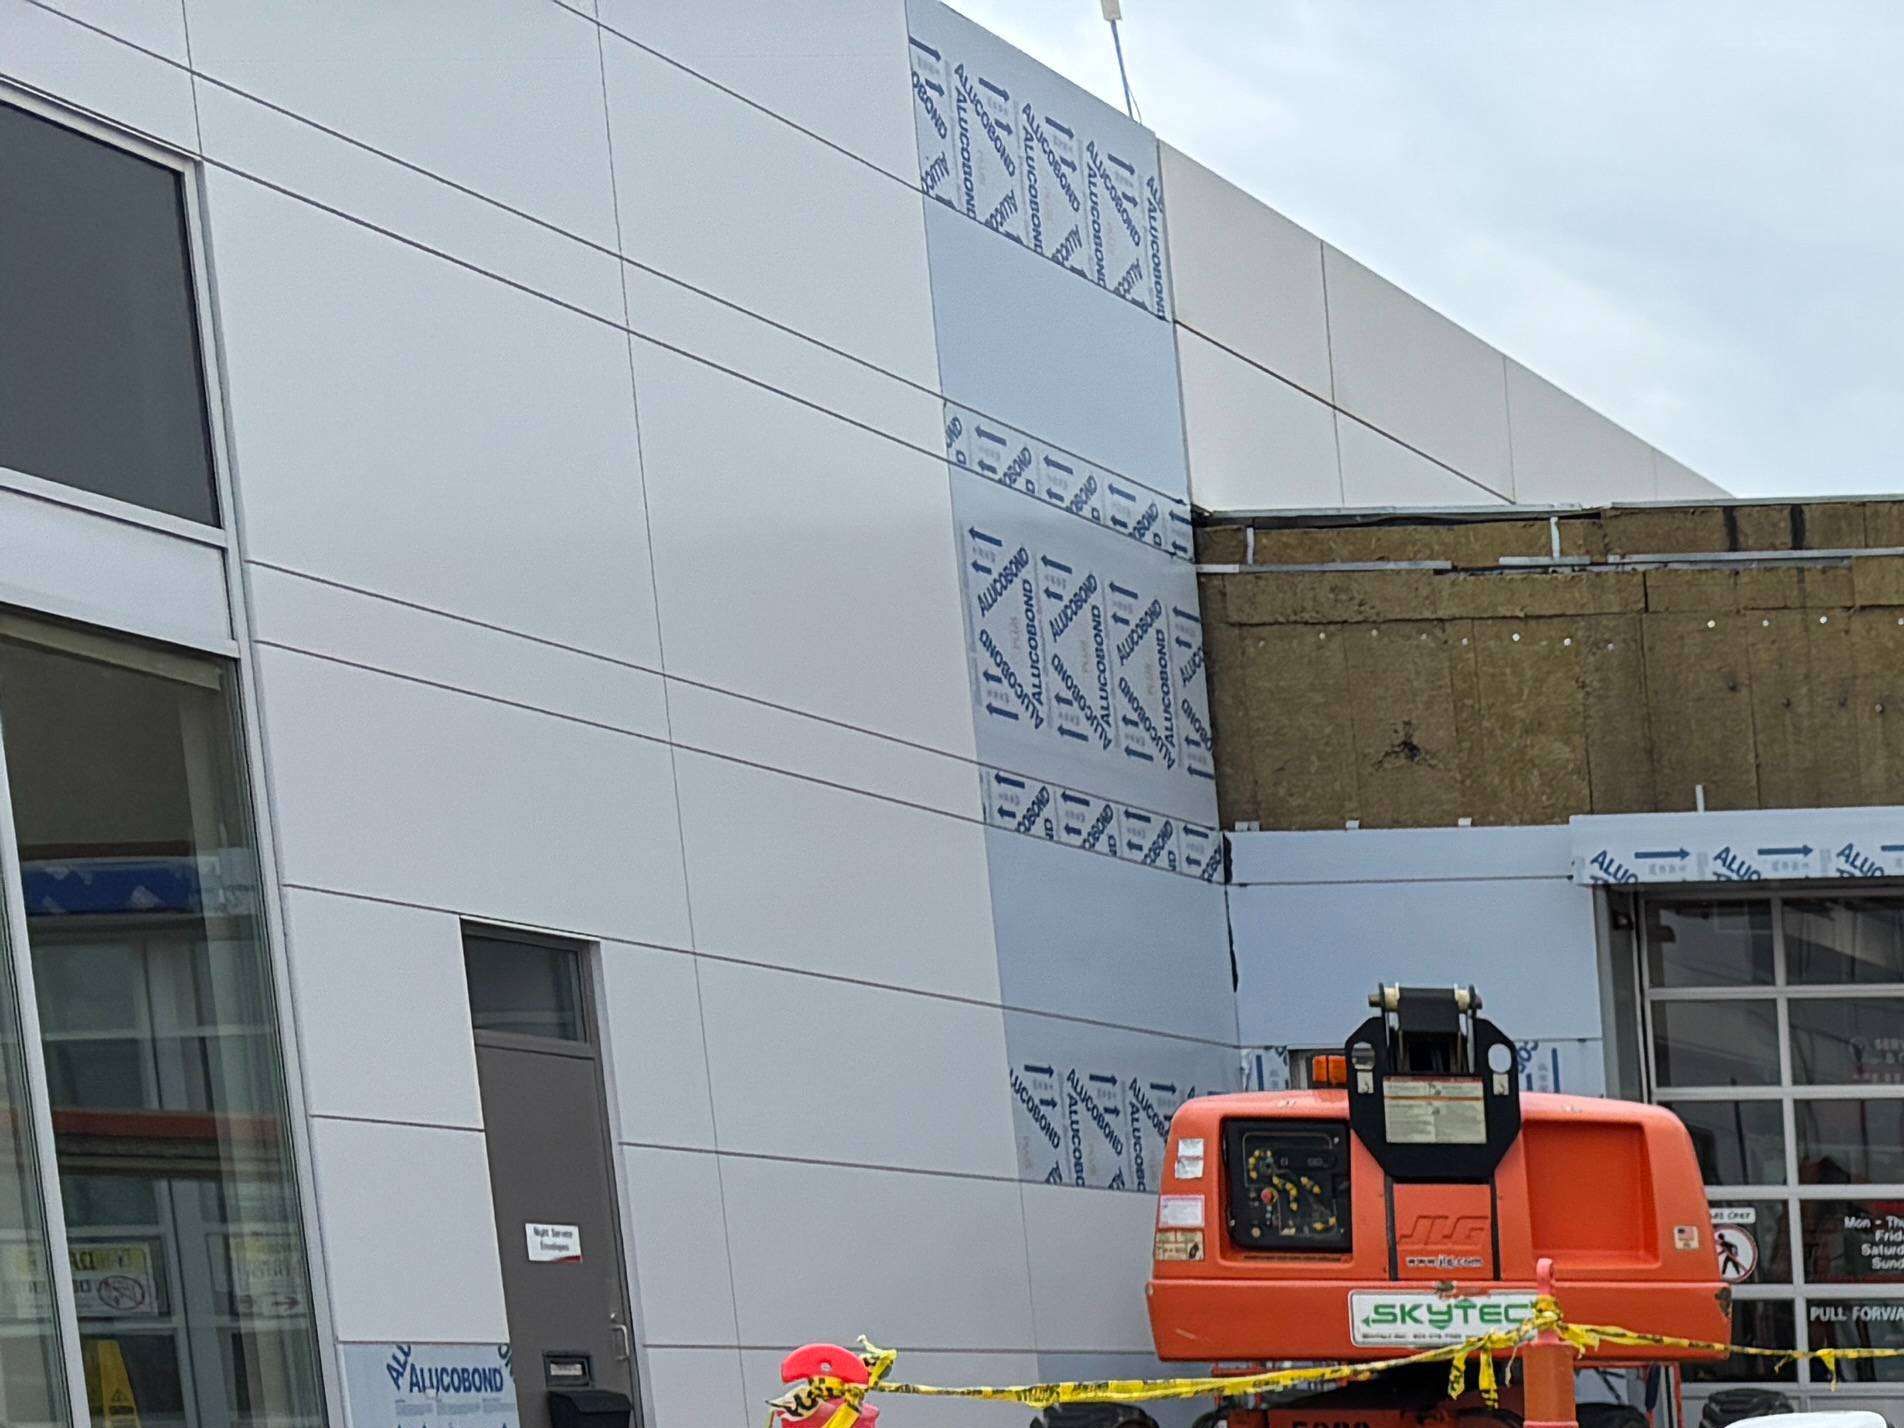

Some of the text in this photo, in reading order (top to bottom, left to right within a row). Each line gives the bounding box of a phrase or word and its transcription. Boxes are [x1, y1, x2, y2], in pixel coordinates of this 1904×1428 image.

[1399, 1215, 1489, 1246] JLG
[1844, 1216, 1871, 1228] Mon
[1810, 1306, 1847, 1321] PULL
[409, 1362, 504, 1393] ALUCOBOND
